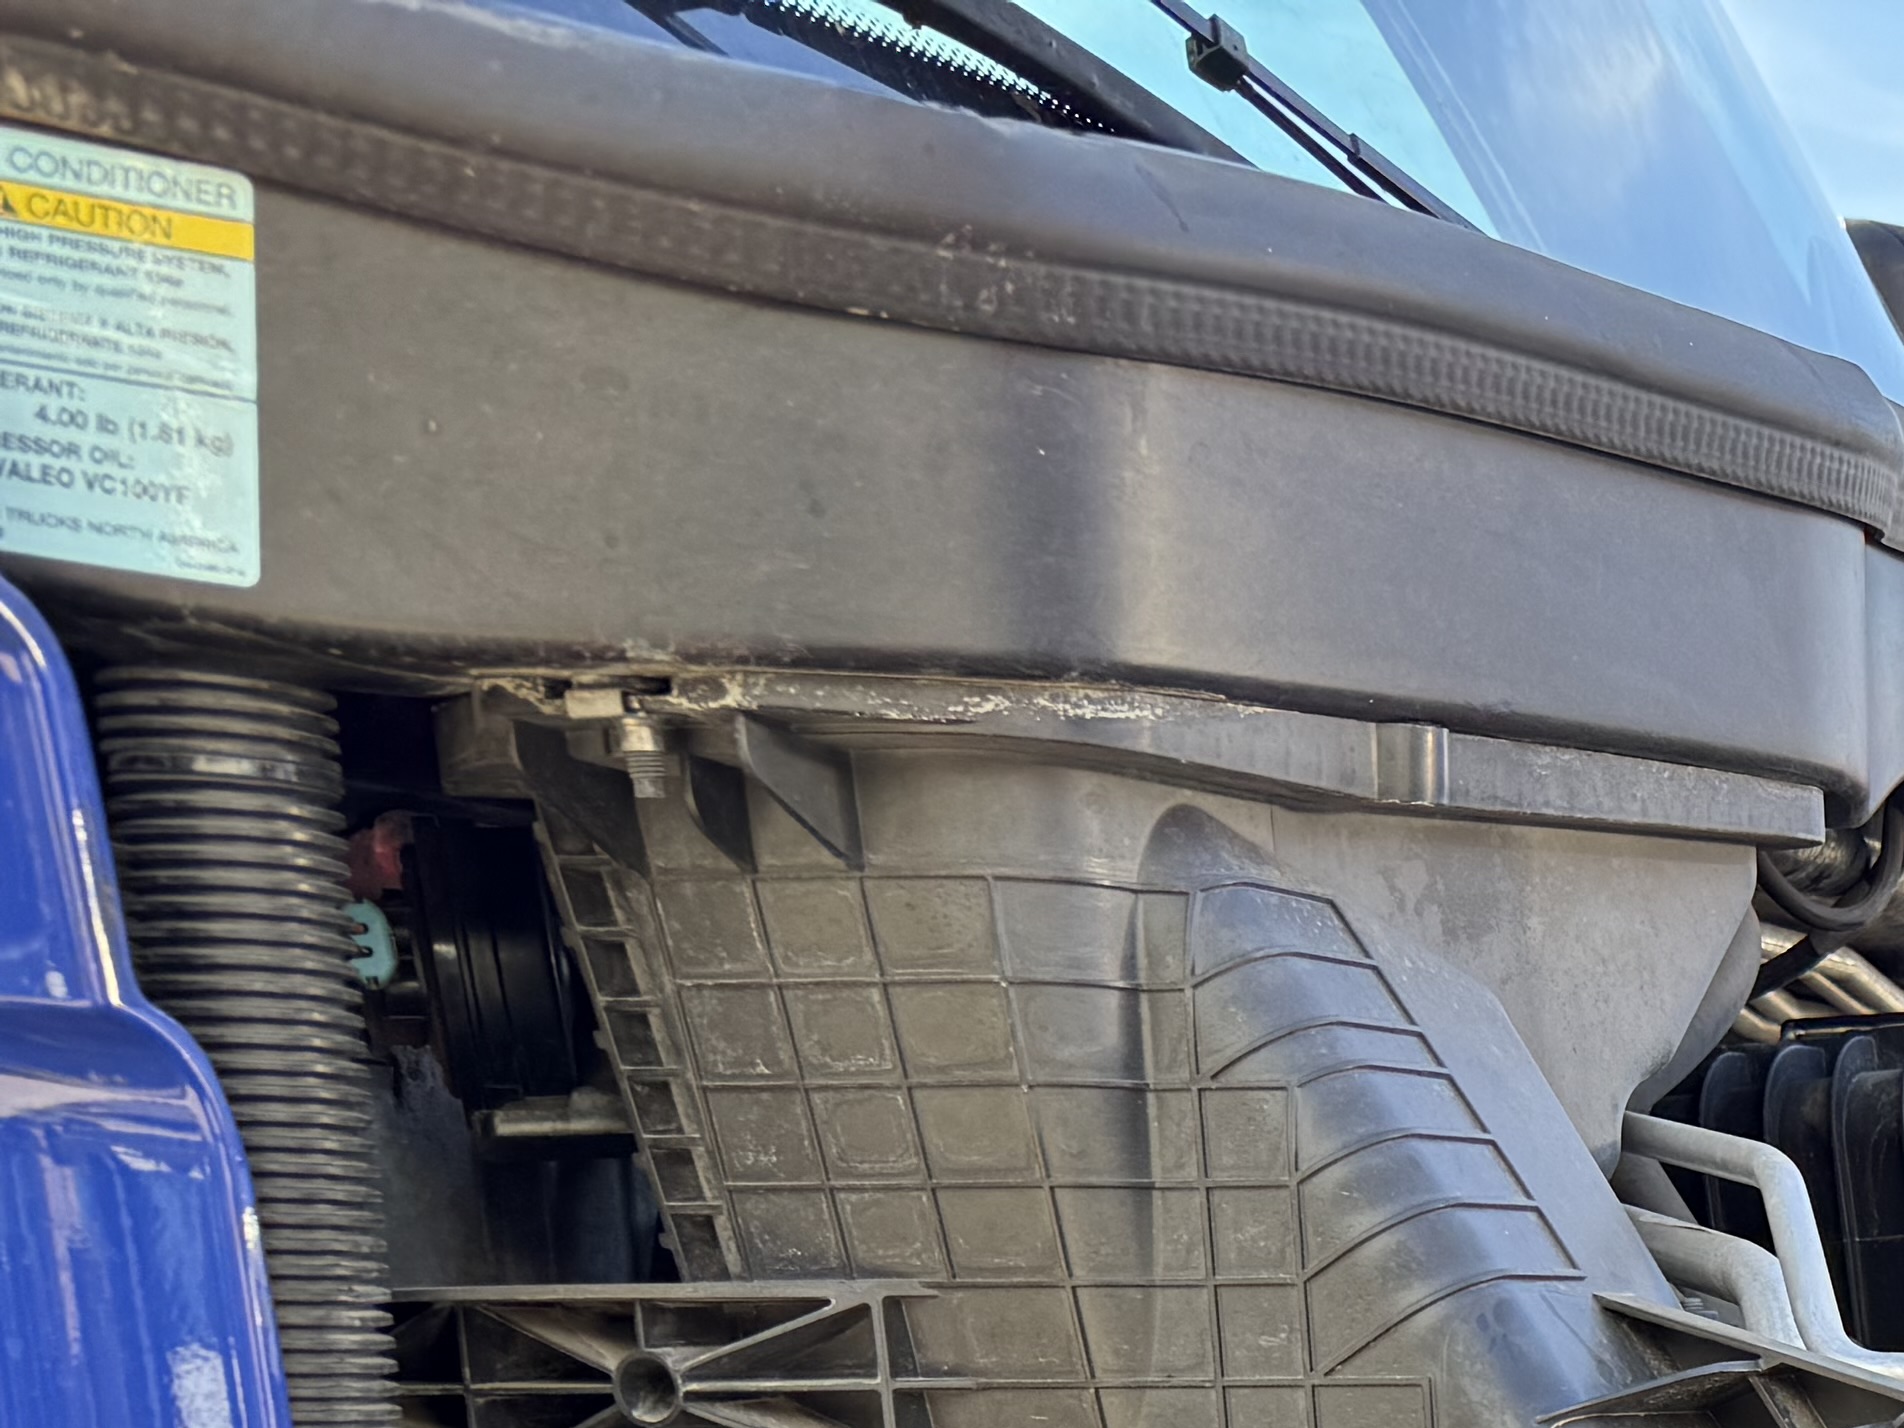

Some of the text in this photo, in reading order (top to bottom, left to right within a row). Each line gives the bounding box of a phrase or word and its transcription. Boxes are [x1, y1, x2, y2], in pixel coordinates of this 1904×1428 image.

[8, 146, 238, 210] CONDITIONER
[27, 192, 174, 240] CAUTION
[35, 405, 89, 431] 4.00
